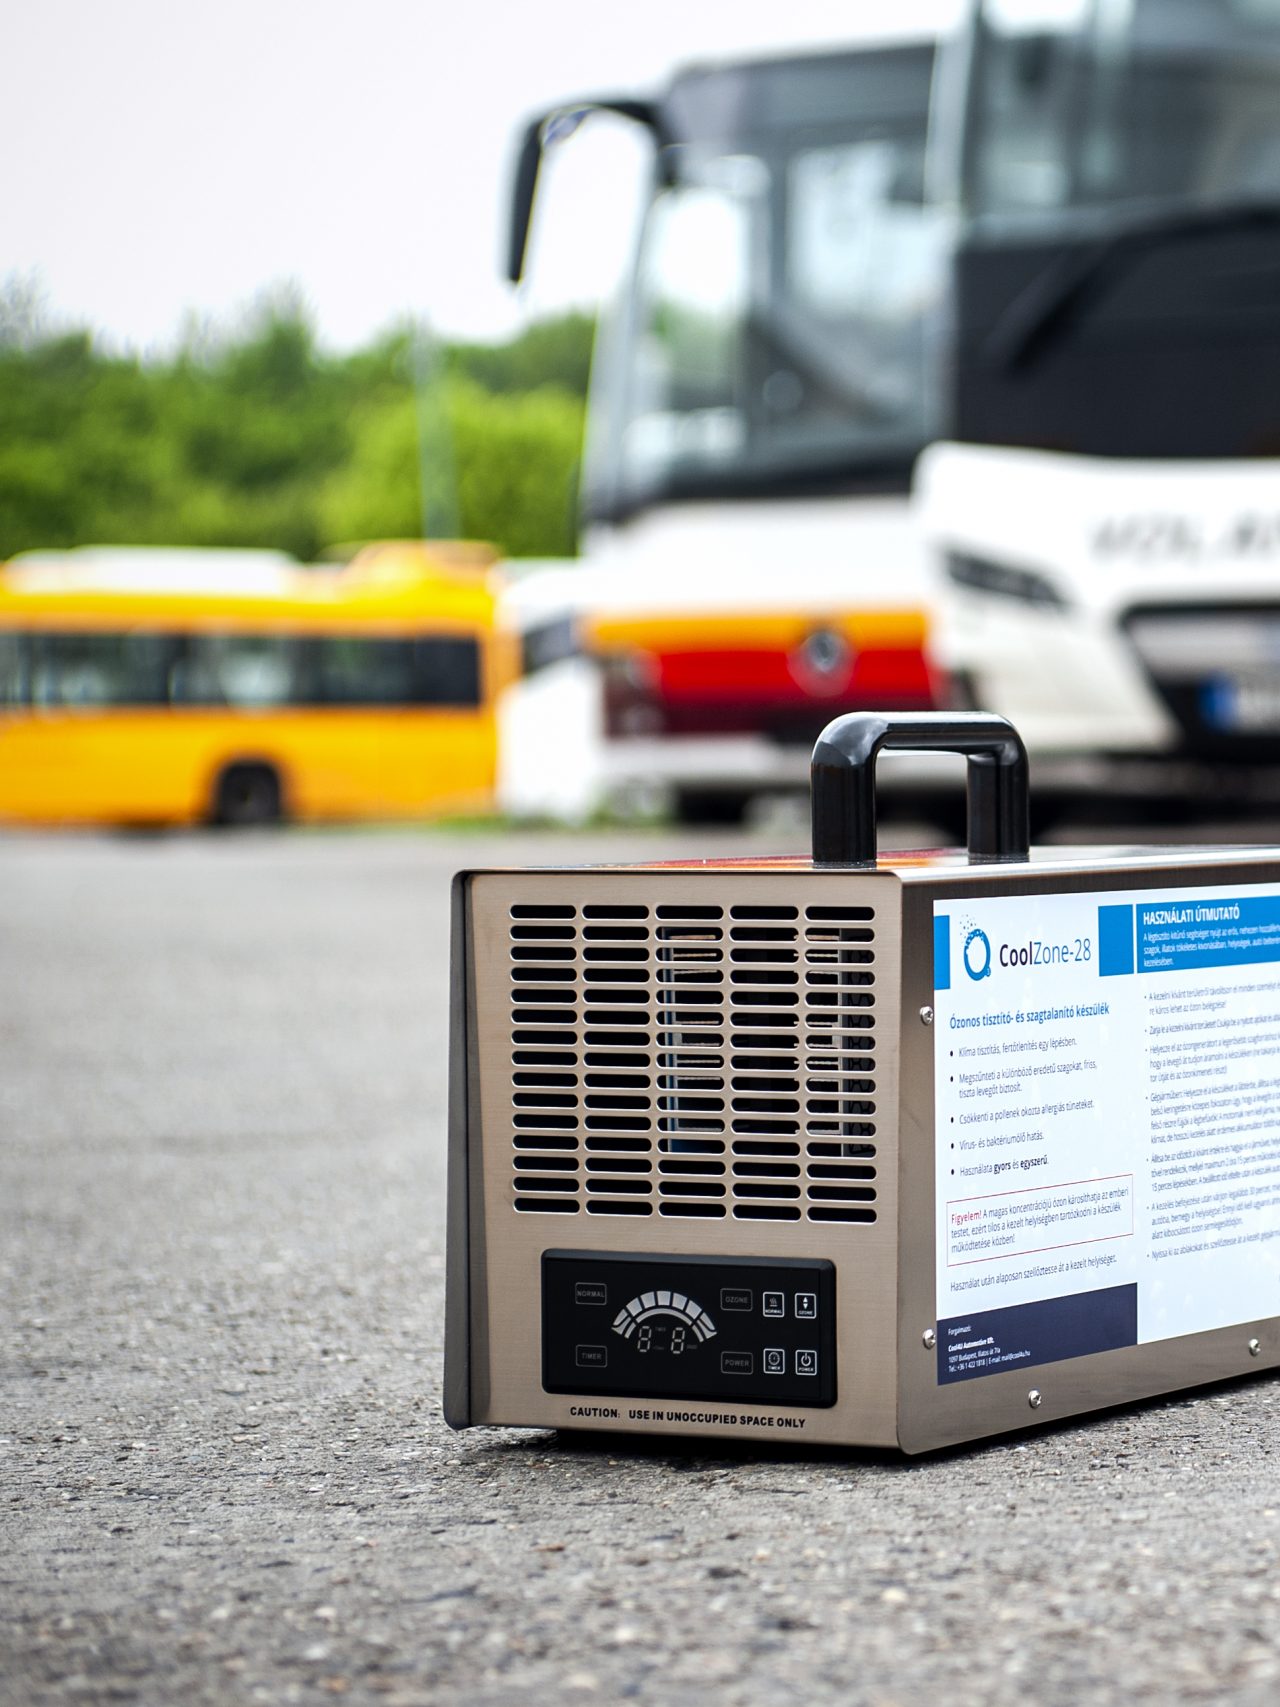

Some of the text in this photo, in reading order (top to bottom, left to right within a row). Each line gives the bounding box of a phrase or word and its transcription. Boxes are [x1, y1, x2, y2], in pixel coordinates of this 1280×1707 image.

[1143, 903, 1240, 925] HASZNÁLATI ÚTMUTATÓ
[1000, 939, 1090, 967] CoolZone-28
[950, 1014, 980, 1029] Ózonos
[983, 1012, 1013, 1026] tisztító-
[1016, 1010, 1024, 1023] és
[1027, 1006, 1074, 1024] szagtalanító
[959, 1047, 976, 1057] Klíma
[977, 1044, 1001, 1055] tisztítás,
[1039, 1041, 1049, 1051] egy
[1050, 1037, 1076, 1049] lépésben.
[1057, 1061, 1083, 1074] szagokat,
[959, 1089, 975, 1098] tiszta
[990, 1113, 993, 1121] a
[995, 1108, 1020, 1122] pollenek
[1021, 1106, 1040, 1117] okozta
[1042, 1104, 1065, 1115] allergiás
[978, 1138, 985, 1148] és
[1027, 1132, 1044, 1141] hatás.
[960, 1155, 1048, 1176] Használata gyors és egyszerű.
[952, 1210, 981, 1225] Figyelem!
[983, 1210, 987, 1218] A
[989, 1208, 1008, 1219] magas
[1053, 1199, 1067, 1207] ózon
[1102, 1192, 1108, 1200] az
[1109, 1189, 1128, 1198] emberi
[951, 1228, 970, 1238] testet,
[972, 1225, 986, 1235] ezért
[988, 1222, 1000, 1232] tilos
[1007, 1218, 1023, 1229] kezelt
[1025, 1213, 1059, 1228] helyiségben
[951, 1279, 980, 1291] Használat
[981, 1275, 995, 1286] után
[996, 1272, 1022, 1284] alaposan
[1058, 1262, 1064, 1272] át
[1071, 1260, 1086, 1269] kezelt
[576, 1290, 605, 1298] NORMAL
[725, 1296, 748, 1304] OZONE
[725, 1359, 749, 1367] POWER
[629, 1410, 650, 1419] USE
[653, 1411, 664, 1420] IN
[667, 1412, 737, 1424] UNOCCUPIED
[740, 1416, 773, 1426] SPACE
[777, 1418, 805, 1428] ONLY
